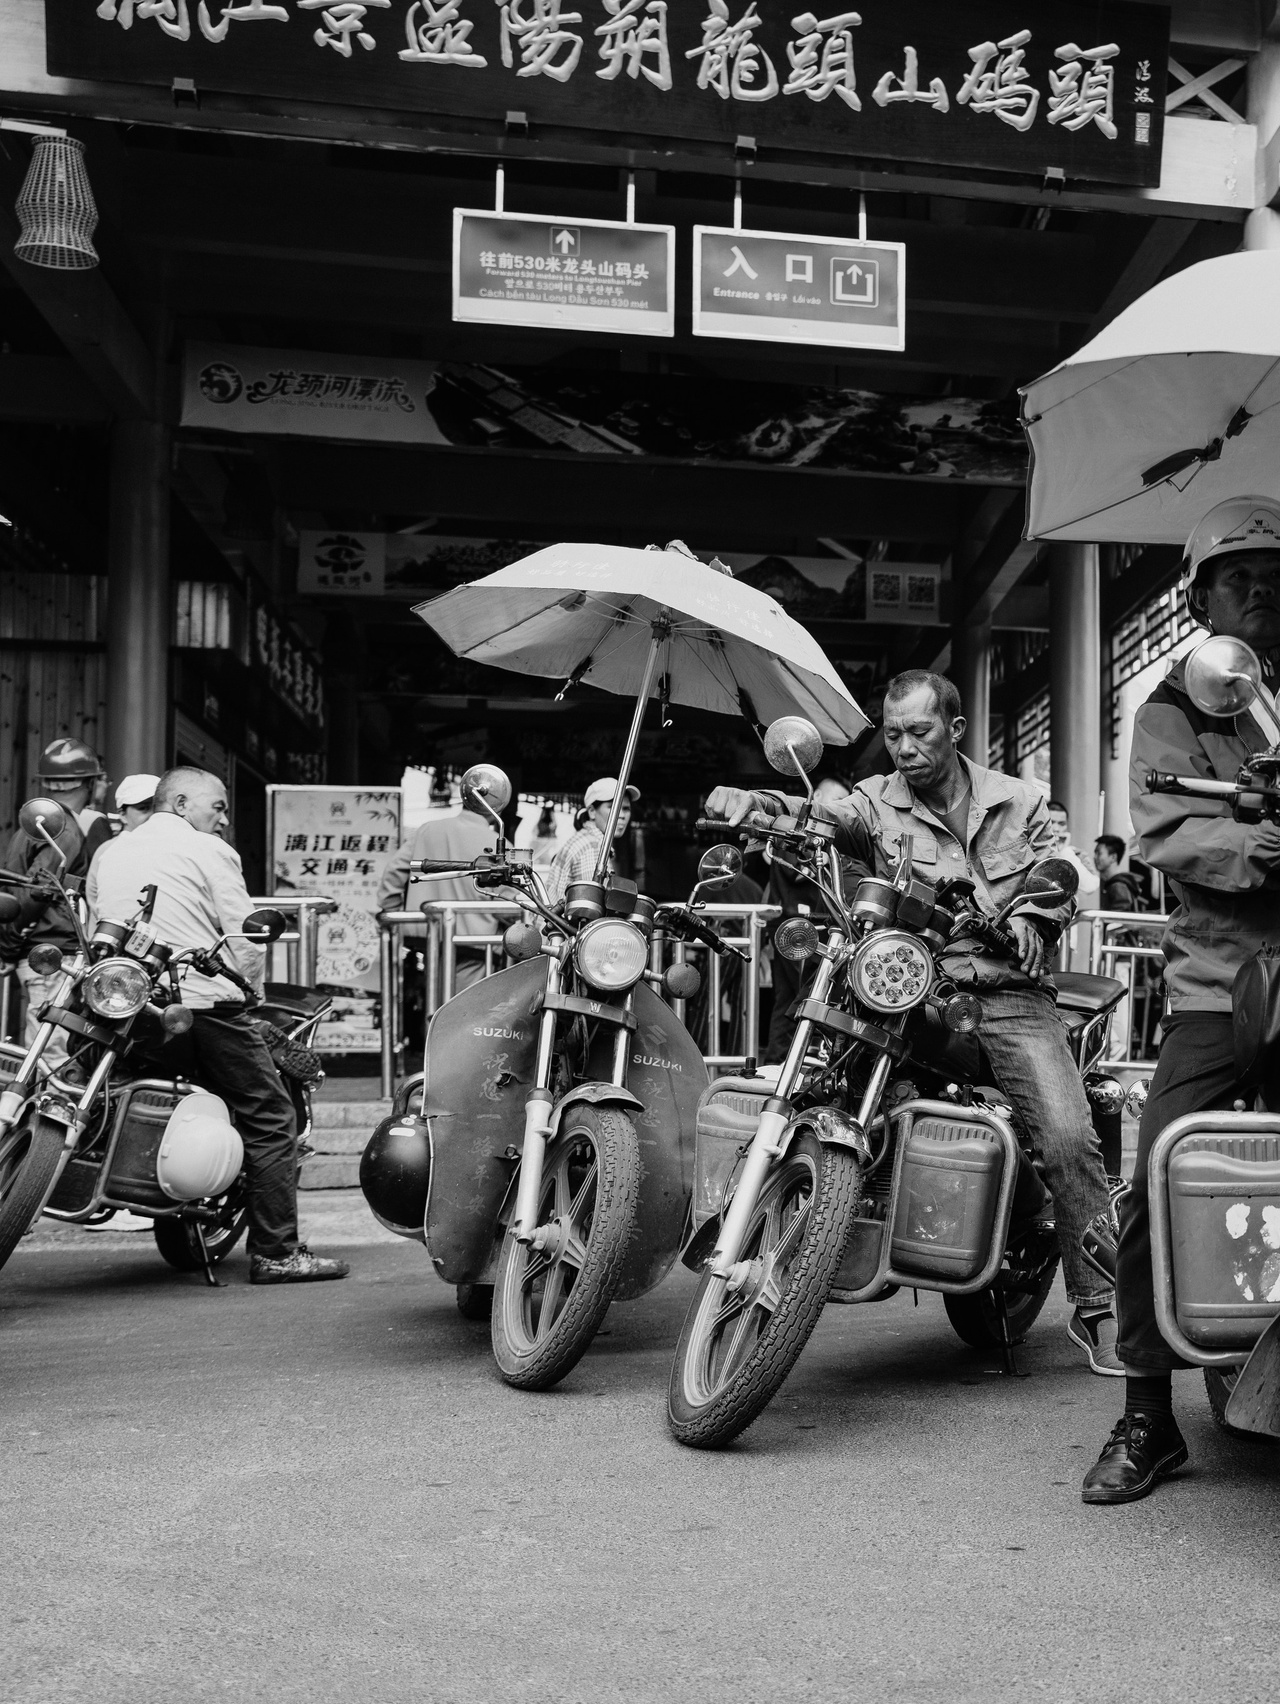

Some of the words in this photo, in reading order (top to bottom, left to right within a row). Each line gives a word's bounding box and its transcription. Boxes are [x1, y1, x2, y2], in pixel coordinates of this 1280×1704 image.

[479, 250, 650, 280] 往前530米龙头山码头
[722, 245, 814, 283] 入口
[486, 267, 520, 278] Forward
[520, 270, 535, 278] 530
[535, 272, 564, 281] meters
[626, 278, 642, 287] Pier
[542, 292, 567, 304] Long
[611, 297, 629, 308] 530
[713, 287, 760, 300] Entrance
[284, 834, 390, 853] 漓江返程
[299, 858, 376, 876] 交通车
[473, 1026, 524, 1042] SUZUKI
[633, 1054, 682, 1072] SUZUKI
